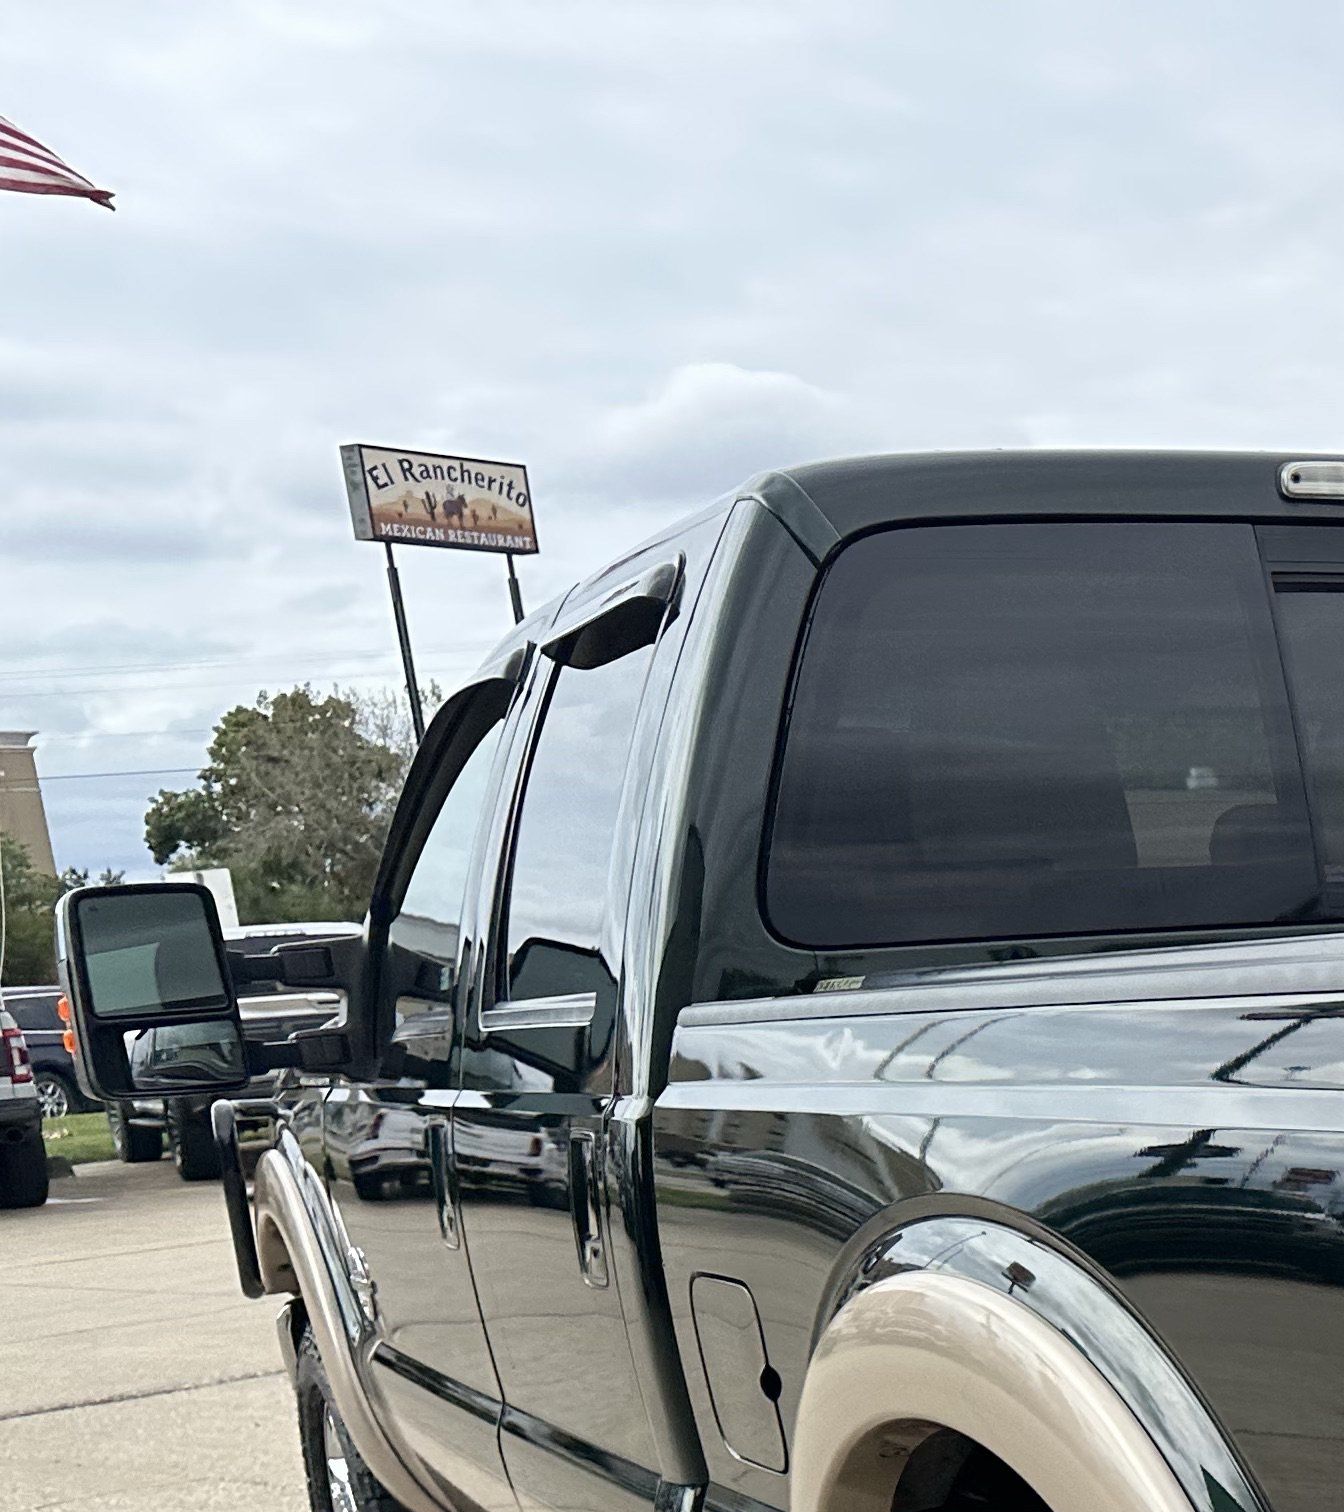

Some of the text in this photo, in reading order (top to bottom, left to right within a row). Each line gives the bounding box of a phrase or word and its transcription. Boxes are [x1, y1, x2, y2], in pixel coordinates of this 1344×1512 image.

[367, 458, 528, 508] El Rancherito
[380, 522, 532, 550] MEXICAN RESTAURANT
